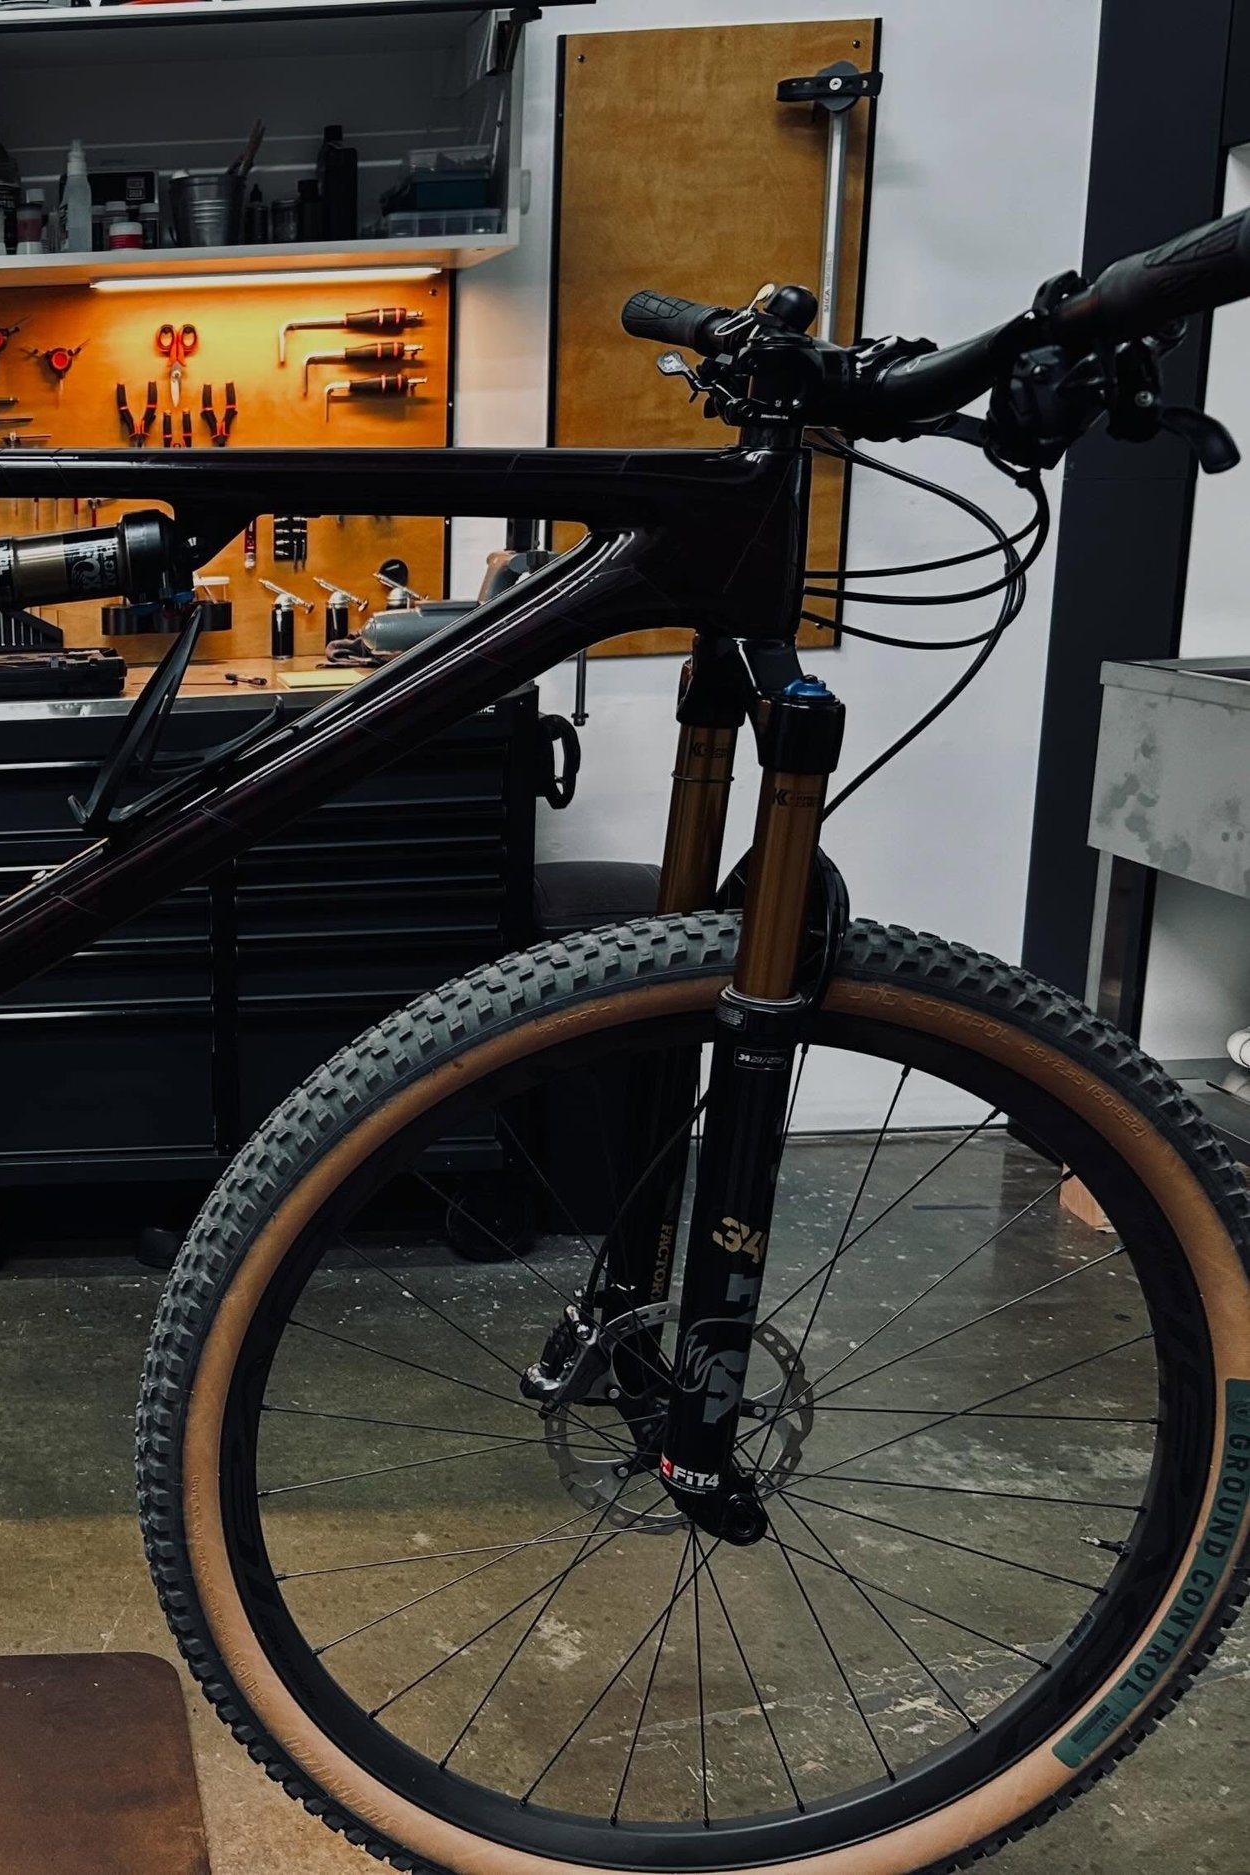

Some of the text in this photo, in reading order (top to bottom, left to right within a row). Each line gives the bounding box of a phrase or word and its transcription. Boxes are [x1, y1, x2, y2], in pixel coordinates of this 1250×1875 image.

[909, 996, 1010, 1046] CONTROL
[712, 1216, 767, 1264] 34
[1118, 1433, 1250, 1696] GROUND CONTROL
